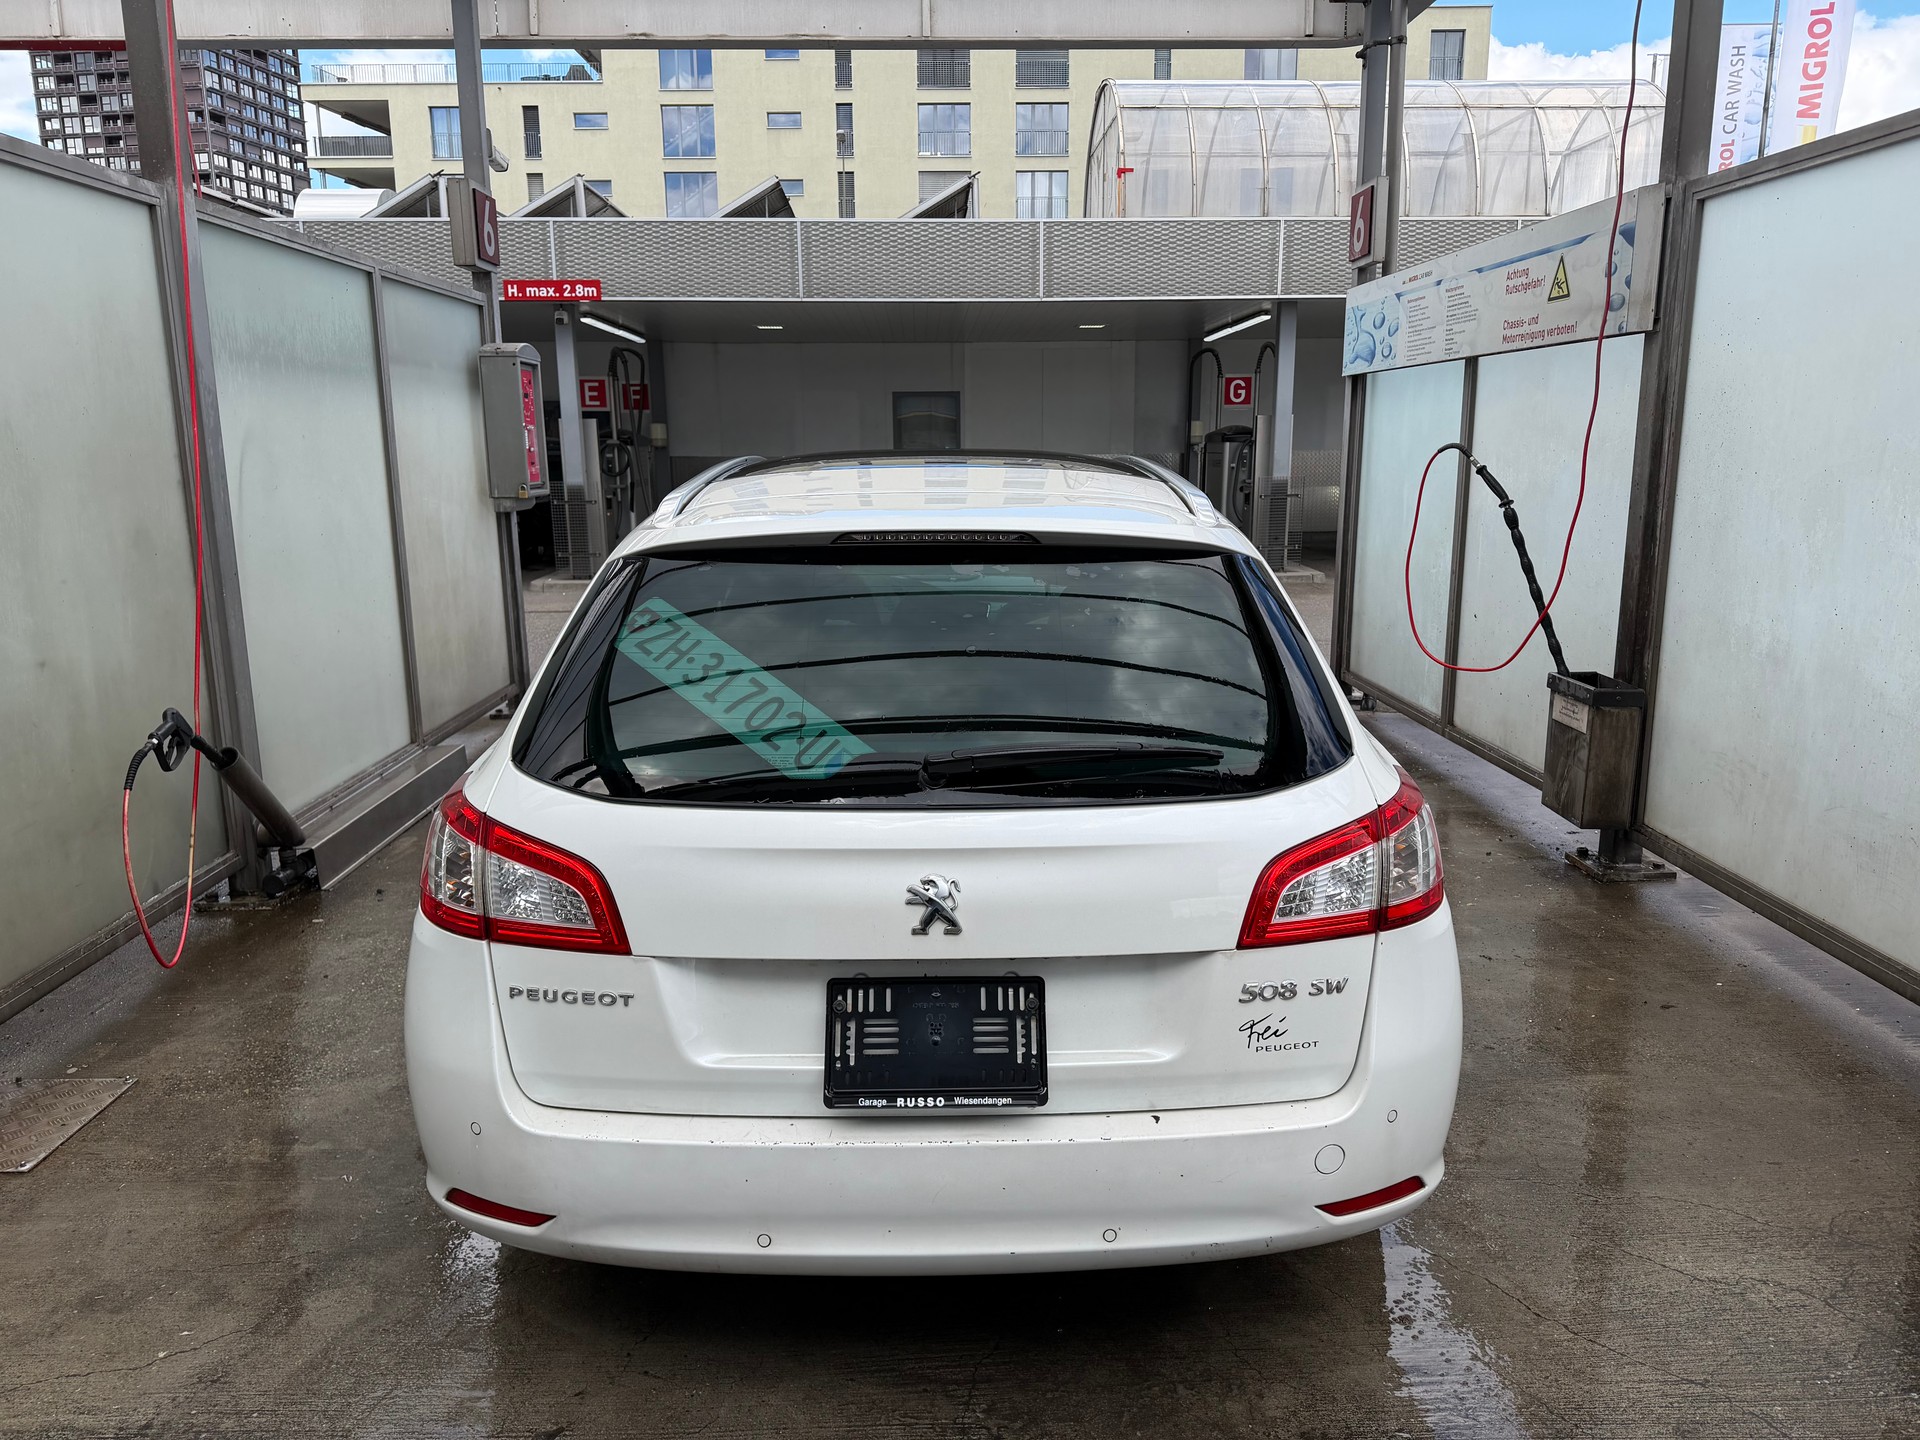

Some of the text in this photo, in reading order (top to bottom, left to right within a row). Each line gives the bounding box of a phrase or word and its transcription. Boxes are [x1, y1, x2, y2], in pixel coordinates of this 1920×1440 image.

[1796, 1, 1835, 119] MIGROL
[1718, 45, 1746, 171] ROL CAR WASH
[483, 200, 495, 257] 6
[1354, 195, 1365, 253] 6
[1505, 275, 1546, 295] Rutschgefahr!
[1506, 267, 1530, 281] Achtung
[507, 284, 598, 298] H. max. 2.8m
[1502, 321, 1578, 345] Motorreinigung verboten!
[1503, 313, 1540, 331] Chassis- und
[584, 381, 601, 406] E
[629, 386, 643, 406] F
[1229, 379, 1246, 403] G
[508, 984, 635, 1007] PEUGEOT
[1238, 975, 1349, 1004] 508 SW
[1255, 1040, 1320, 1053] PEUGEOT
[858, 1096, 1012, 1108] Garage RUSSO Wiesendangen
